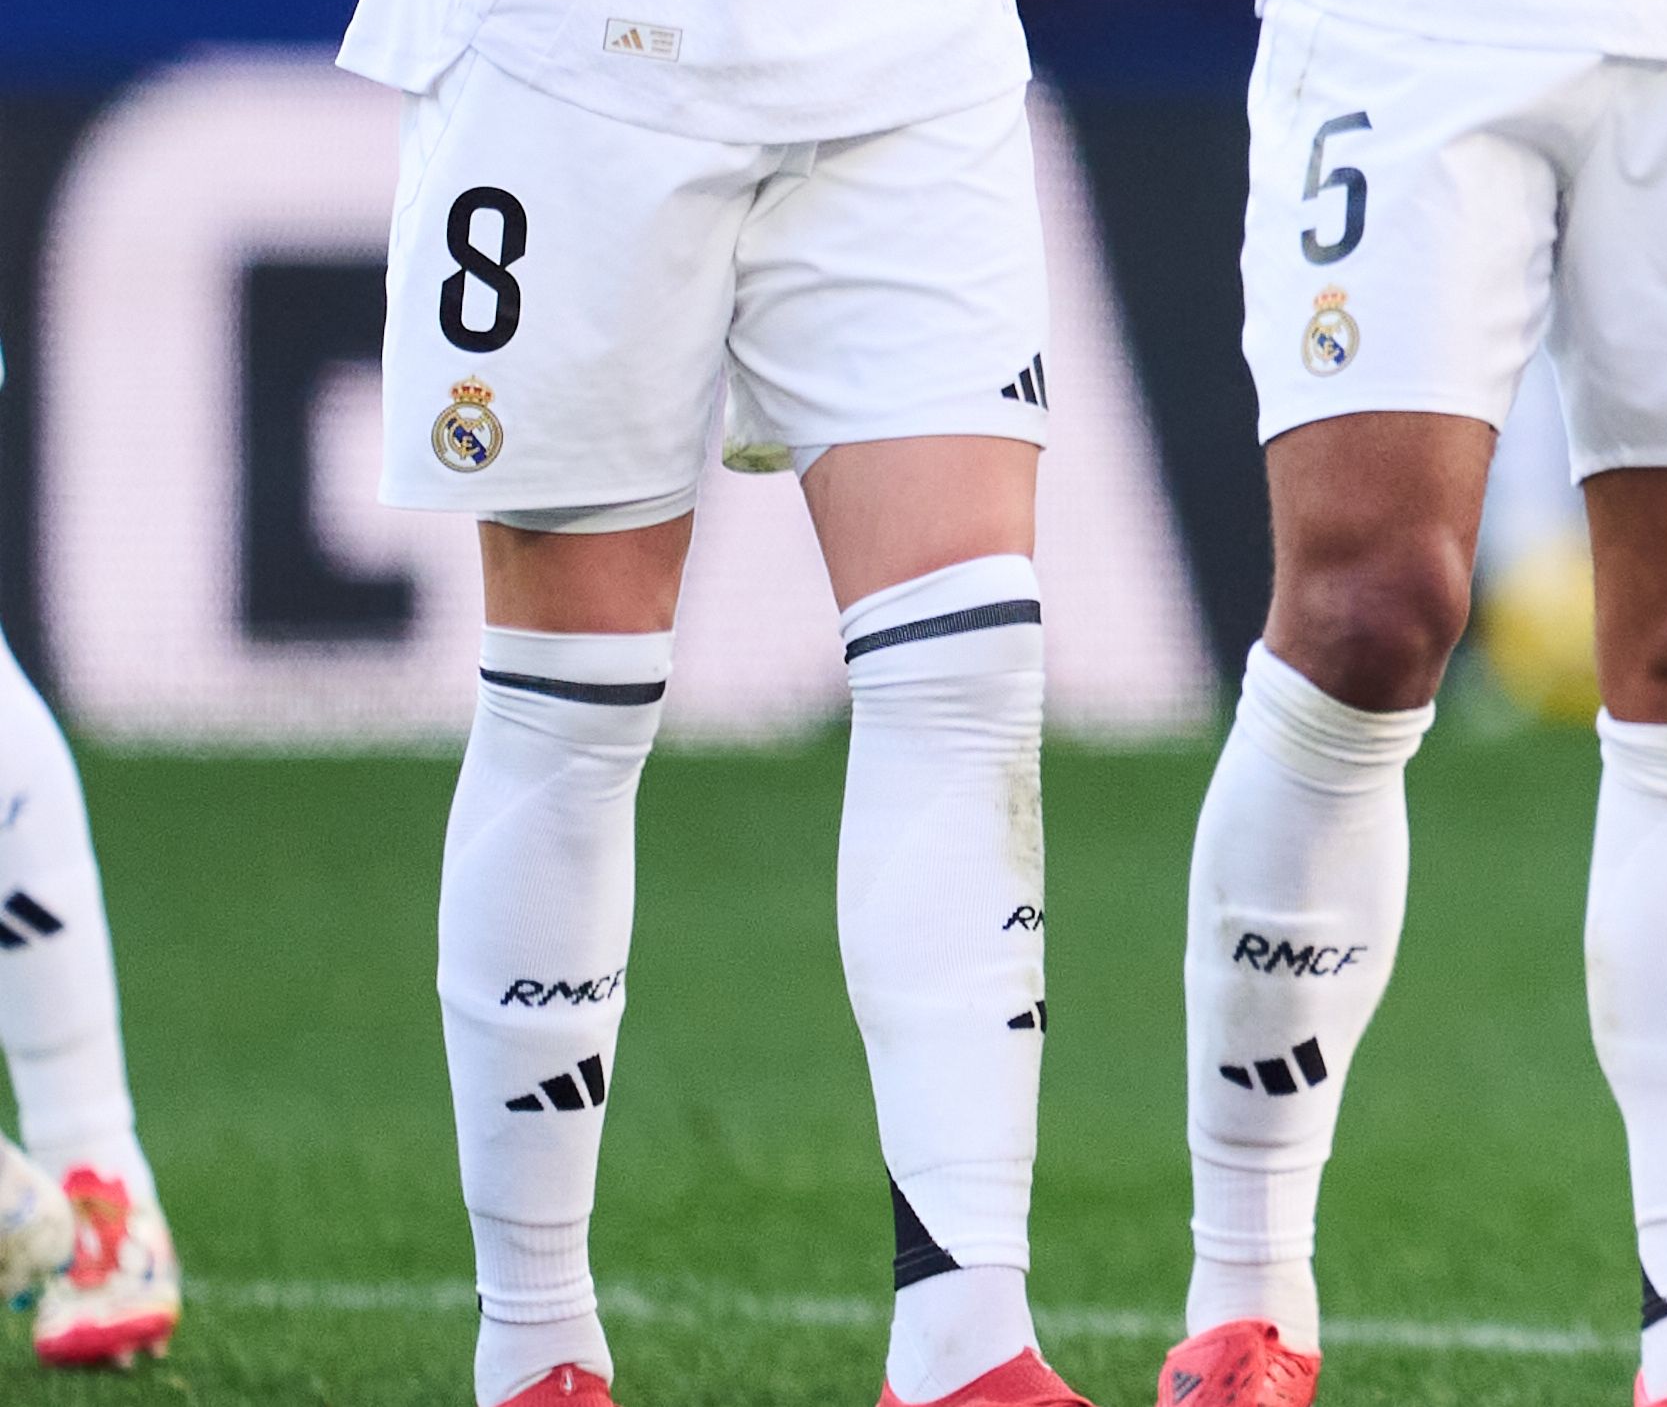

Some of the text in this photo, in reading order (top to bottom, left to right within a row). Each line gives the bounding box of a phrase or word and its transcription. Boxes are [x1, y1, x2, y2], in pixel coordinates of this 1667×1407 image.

[1300, 111, 1374, 266] 5
[439, 186, 528, 354] 8
[500, 968, 625, 1006] RMCF
[1233, 931, 1368, 979] RMCF
